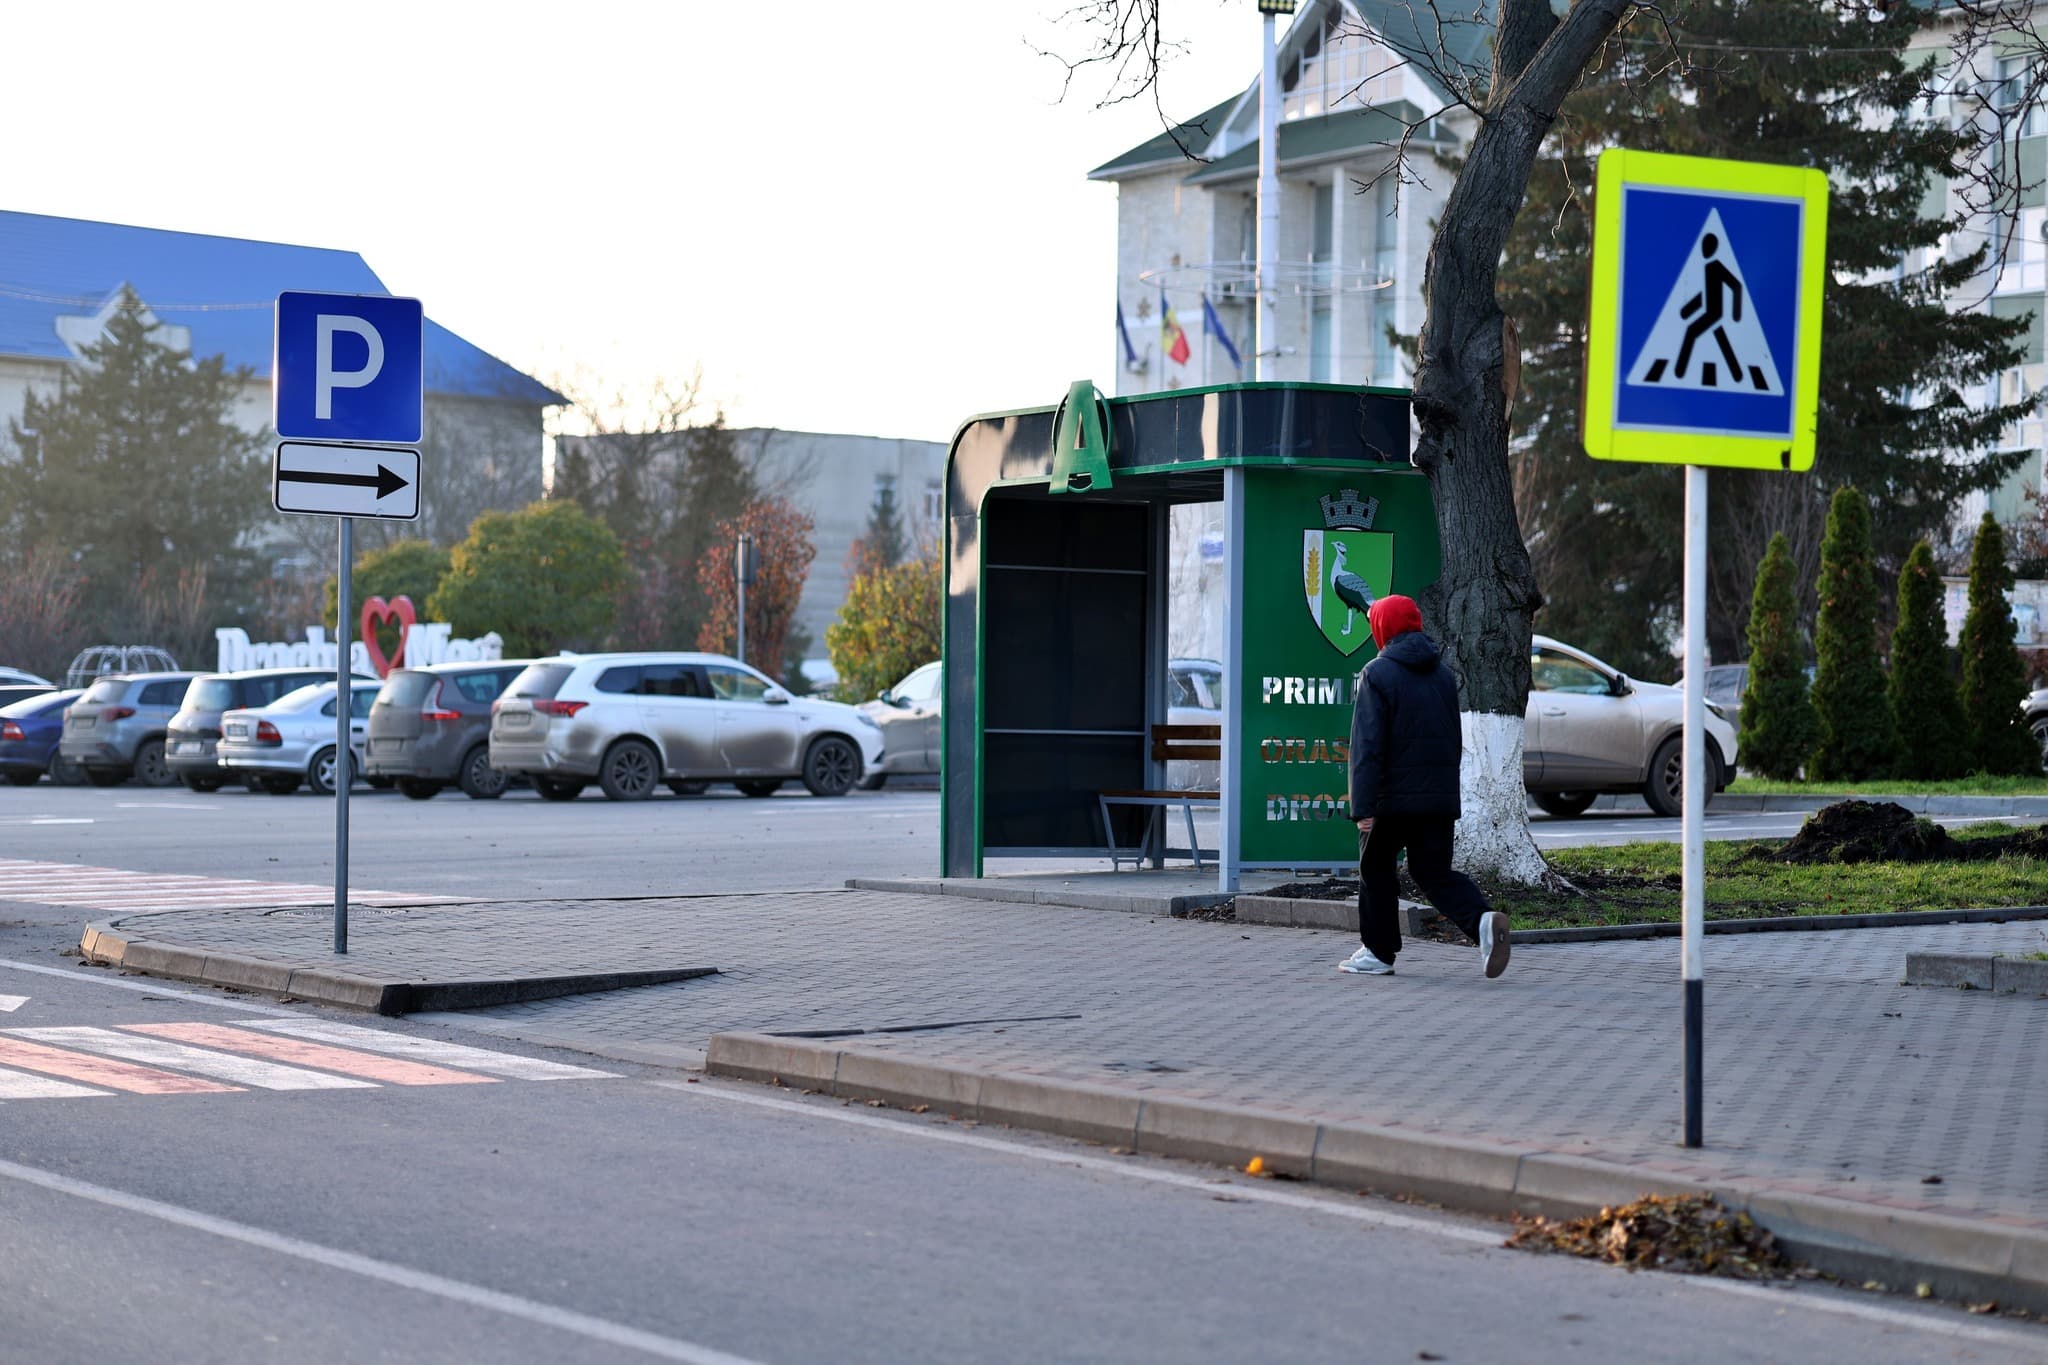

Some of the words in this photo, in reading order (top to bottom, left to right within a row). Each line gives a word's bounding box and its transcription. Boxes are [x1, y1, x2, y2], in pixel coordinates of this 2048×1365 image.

[315, 314, 385, 420] P
[1048, 379, 1113, 494] A
[215, 625, 377, 672] Drocha
